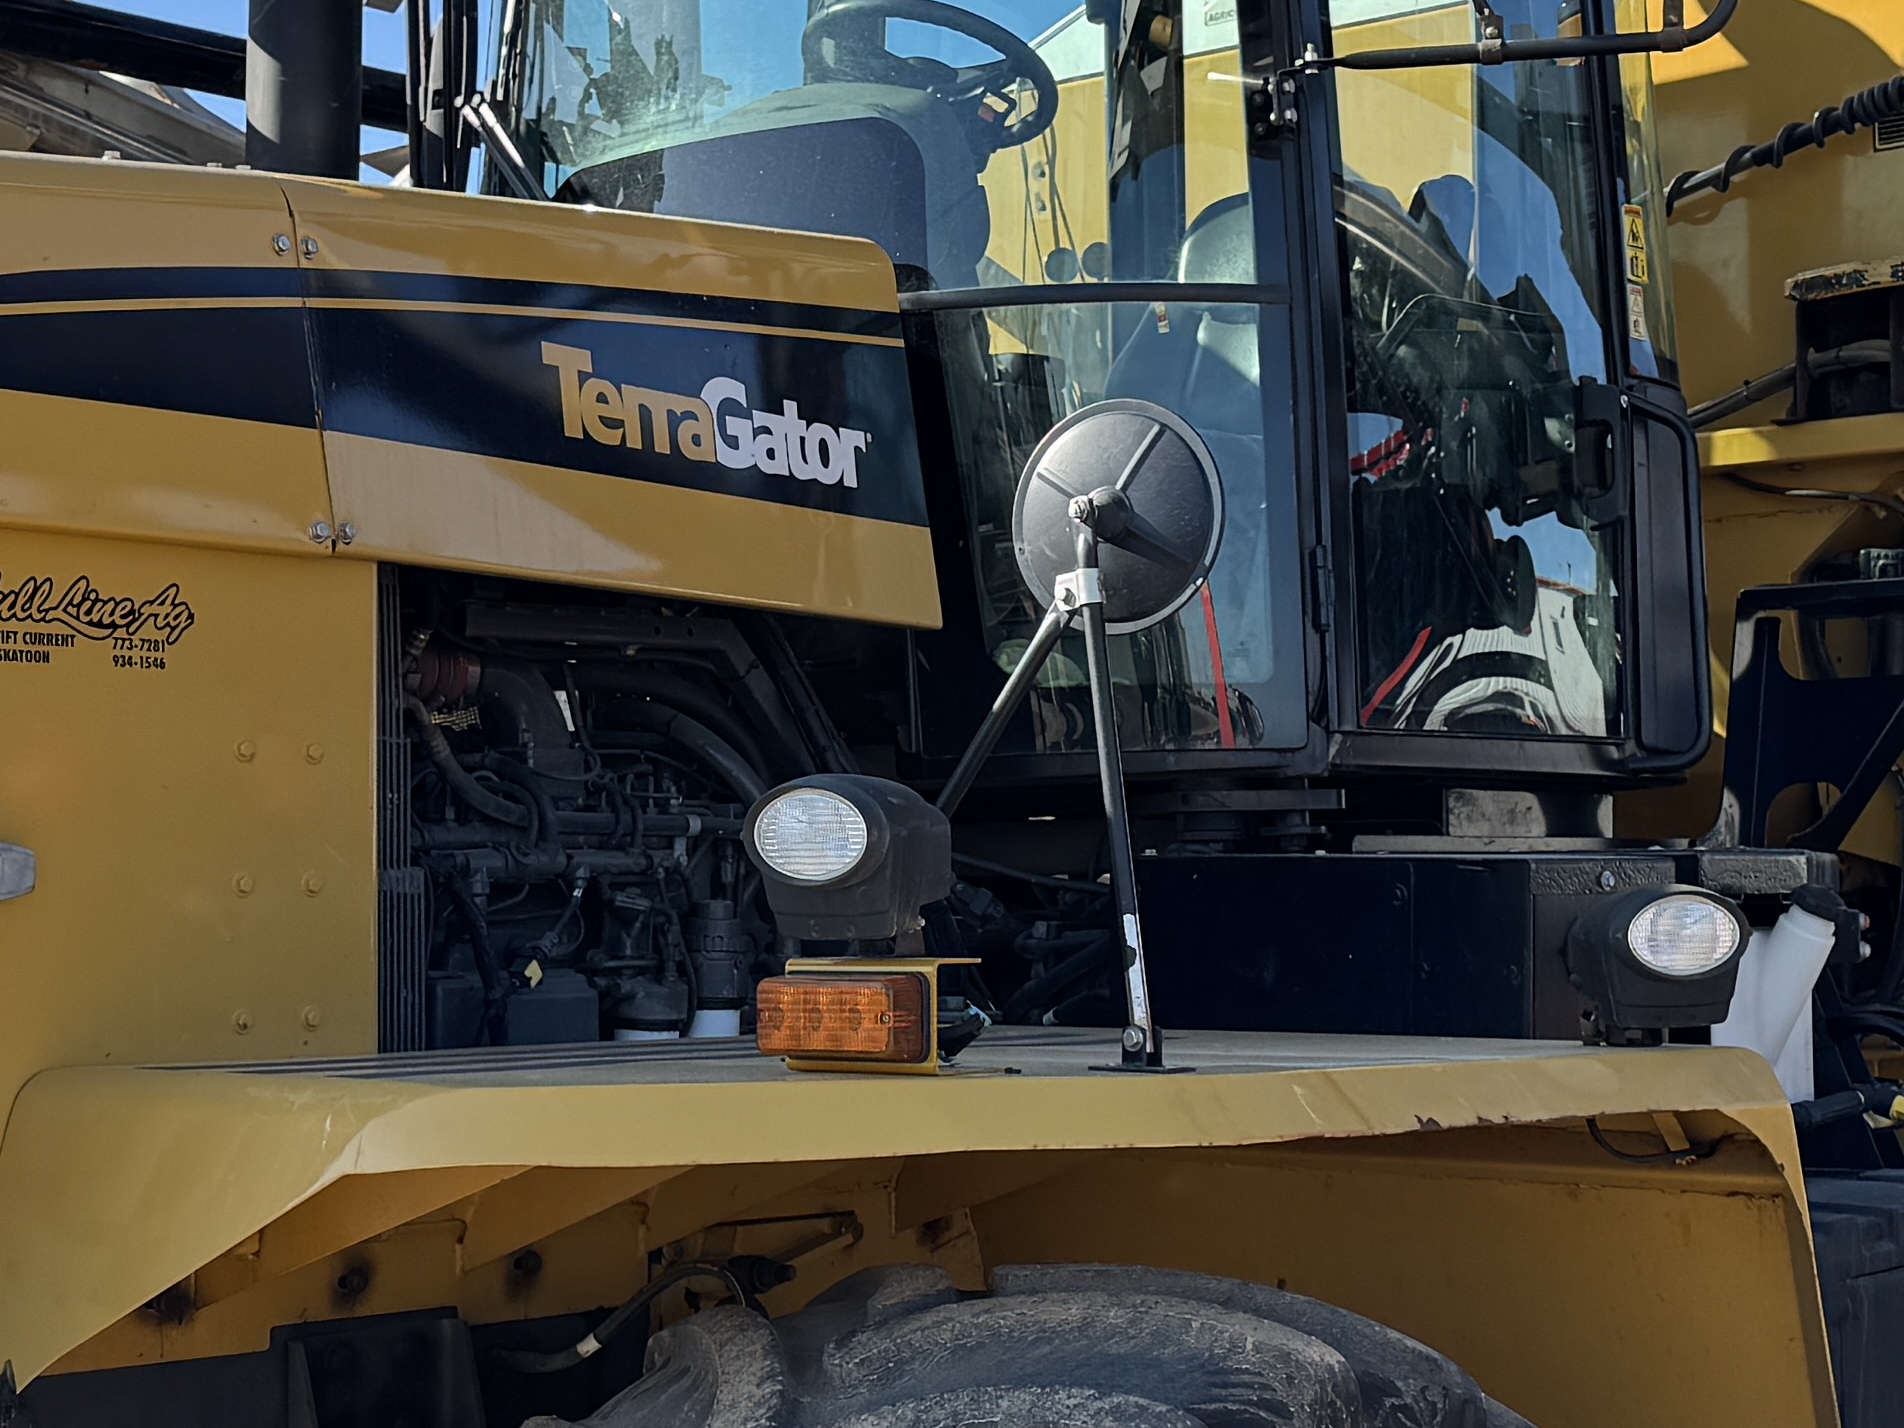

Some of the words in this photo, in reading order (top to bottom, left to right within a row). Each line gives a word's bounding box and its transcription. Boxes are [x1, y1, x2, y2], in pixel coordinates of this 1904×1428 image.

[541, 340, 867, 488] TerraGator
[44, 575, 136, 641] Line
[126, 582, 195, 645] Ag
[23, 631, 77, 648] CURRENT
[112, 636, 166, 653] 773-7281
[112, 654, 166, 670] 934-1546
